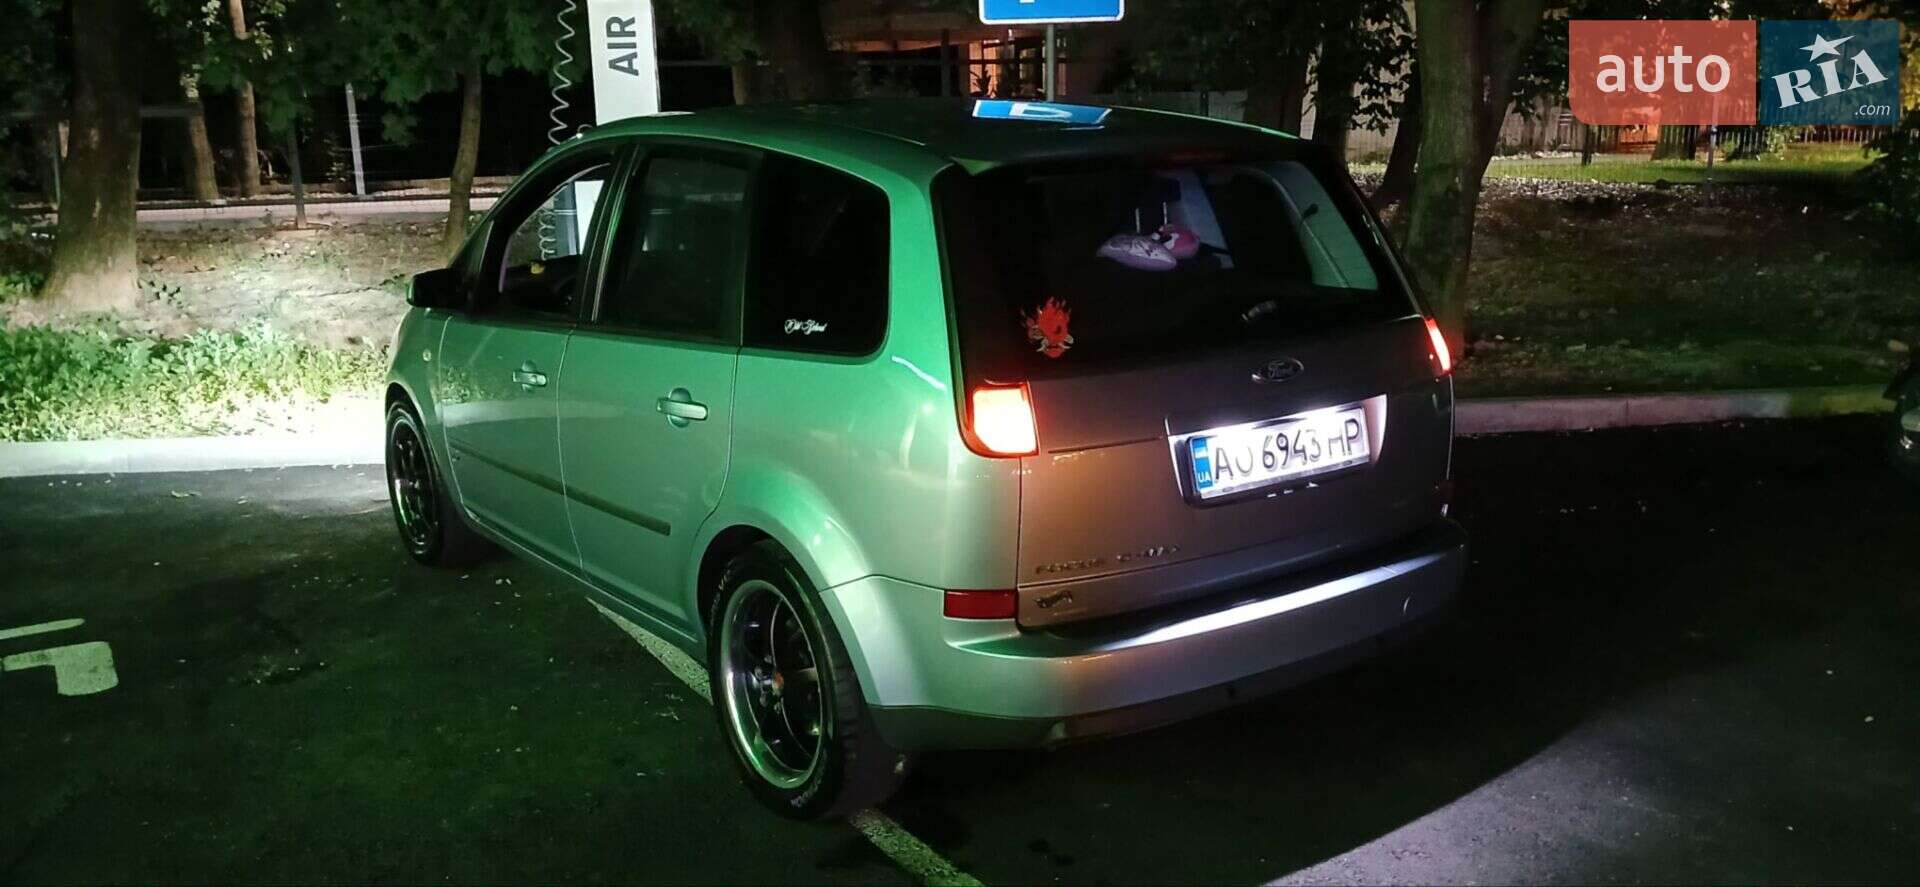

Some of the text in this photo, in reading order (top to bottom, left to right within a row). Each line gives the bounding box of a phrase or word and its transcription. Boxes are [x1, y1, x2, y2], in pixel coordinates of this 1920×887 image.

[606, 16, 639, 76] AIR
[1262, 428, 1321, 470] 6943
[1198, 472, 1212, 482] UA
